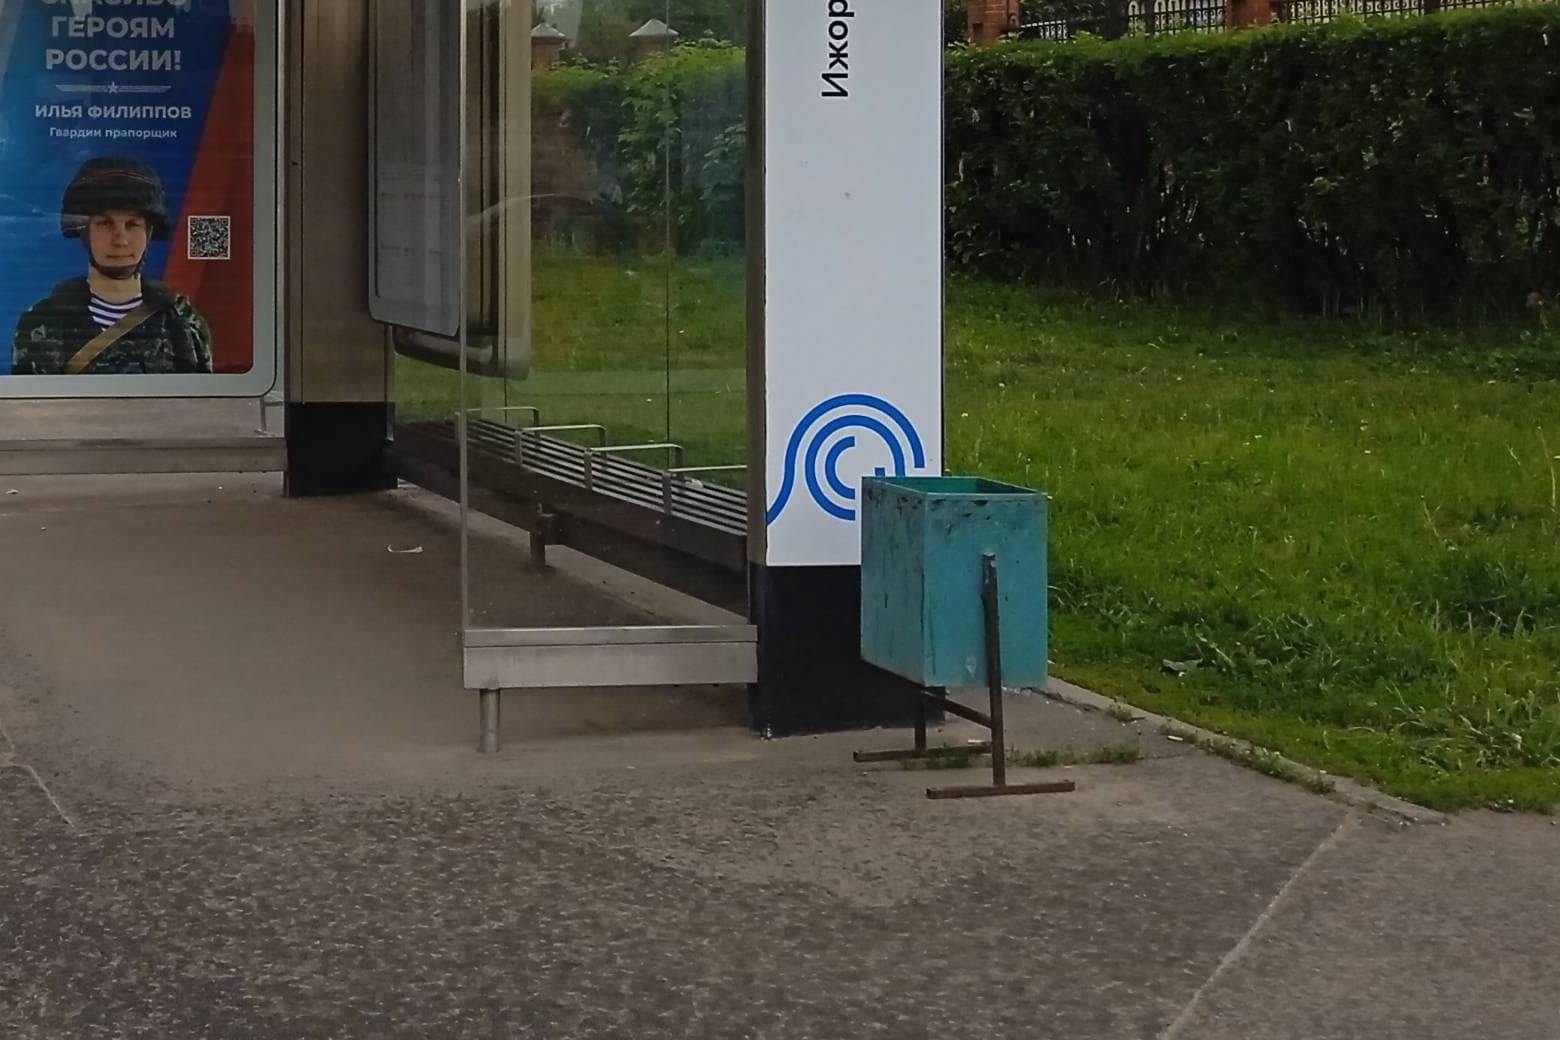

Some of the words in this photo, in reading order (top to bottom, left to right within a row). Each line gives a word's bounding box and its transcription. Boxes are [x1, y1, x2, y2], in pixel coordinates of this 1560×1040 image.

[52, 16, 175, 39] ГЕРОЯМ
[45, 48, 182, 71] РОССИИ!
[35, 105, 82, 118] ИЛЬЯ
[87, 104, 192, 119] ФИЛИППОВ
[50, 126, 102, 139] Гвардии
[105, 128, 177, 140] прапорщик
